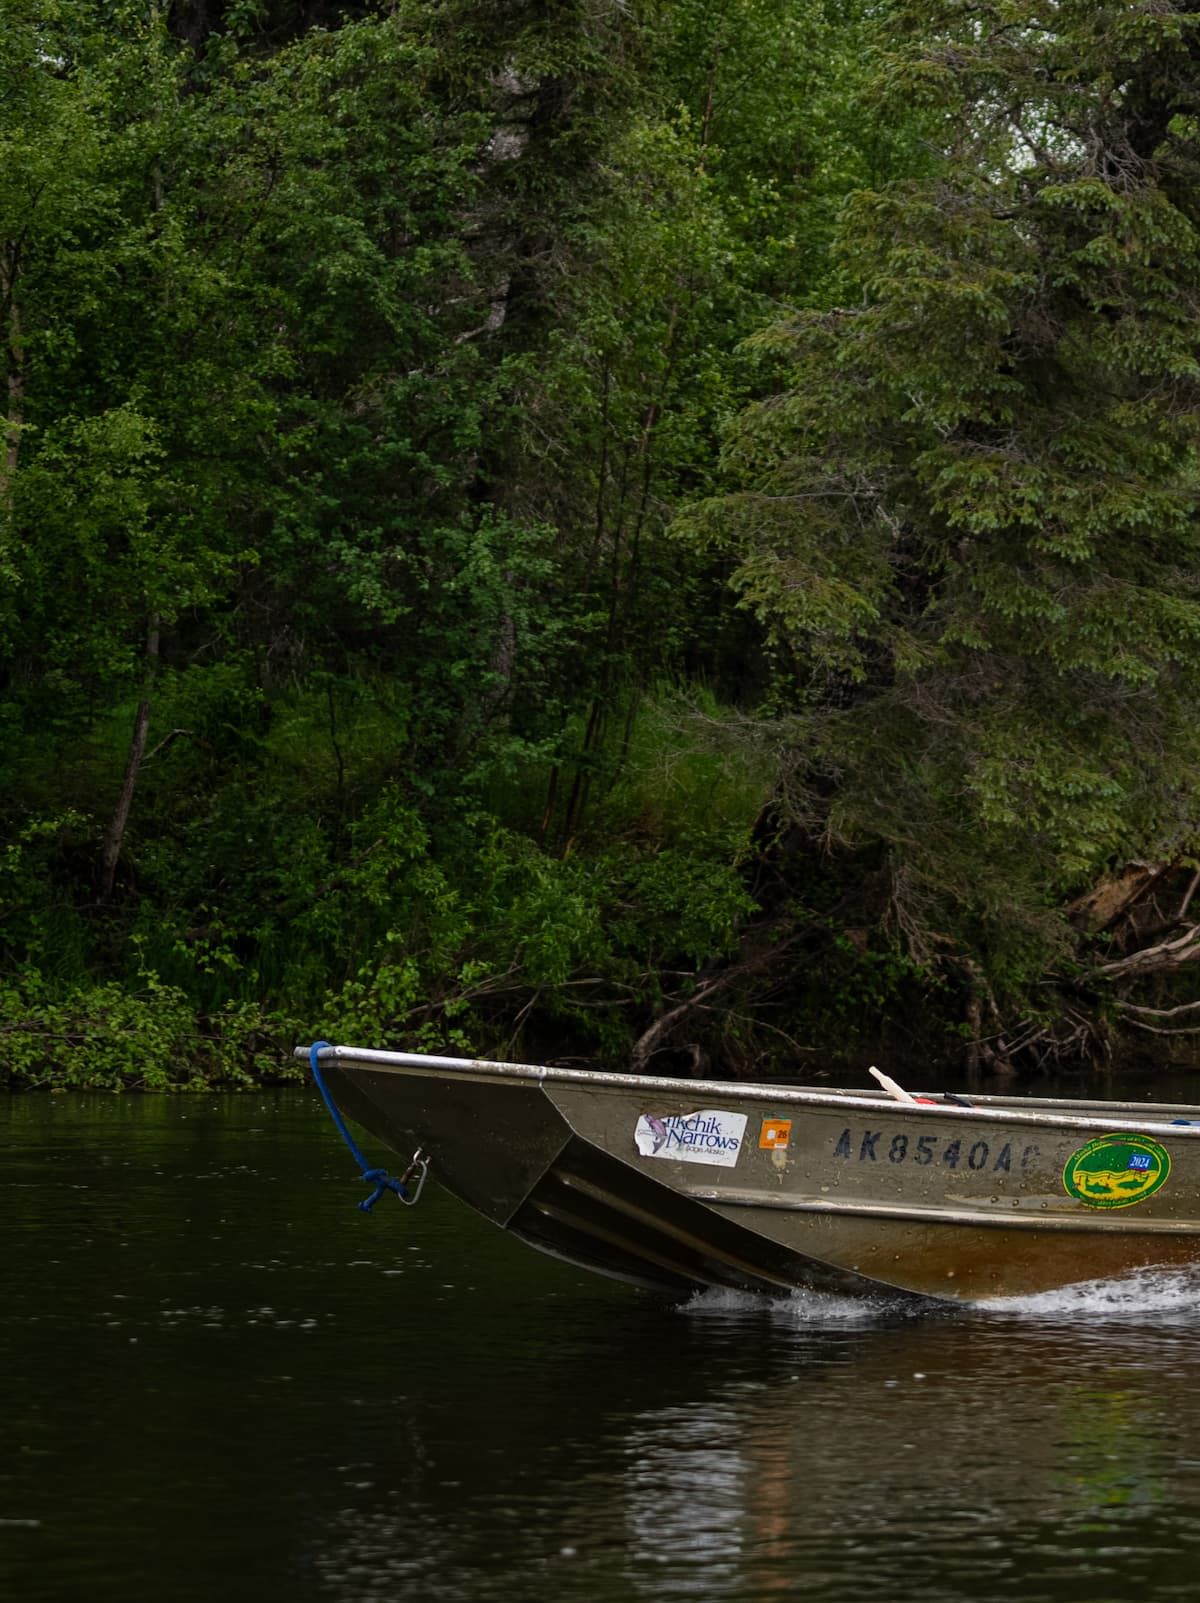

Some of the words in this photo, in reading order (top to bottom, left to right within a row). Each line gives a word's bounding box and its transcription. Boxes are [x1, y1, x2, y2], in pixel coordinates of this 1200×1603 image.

[666, 1114, 722, 1135] ikchik
[665, 1129, 740, 1151] Narrows
[777, 1129, 788, 1139] 26
[1130, 1156, 1151, 1169] 2024
